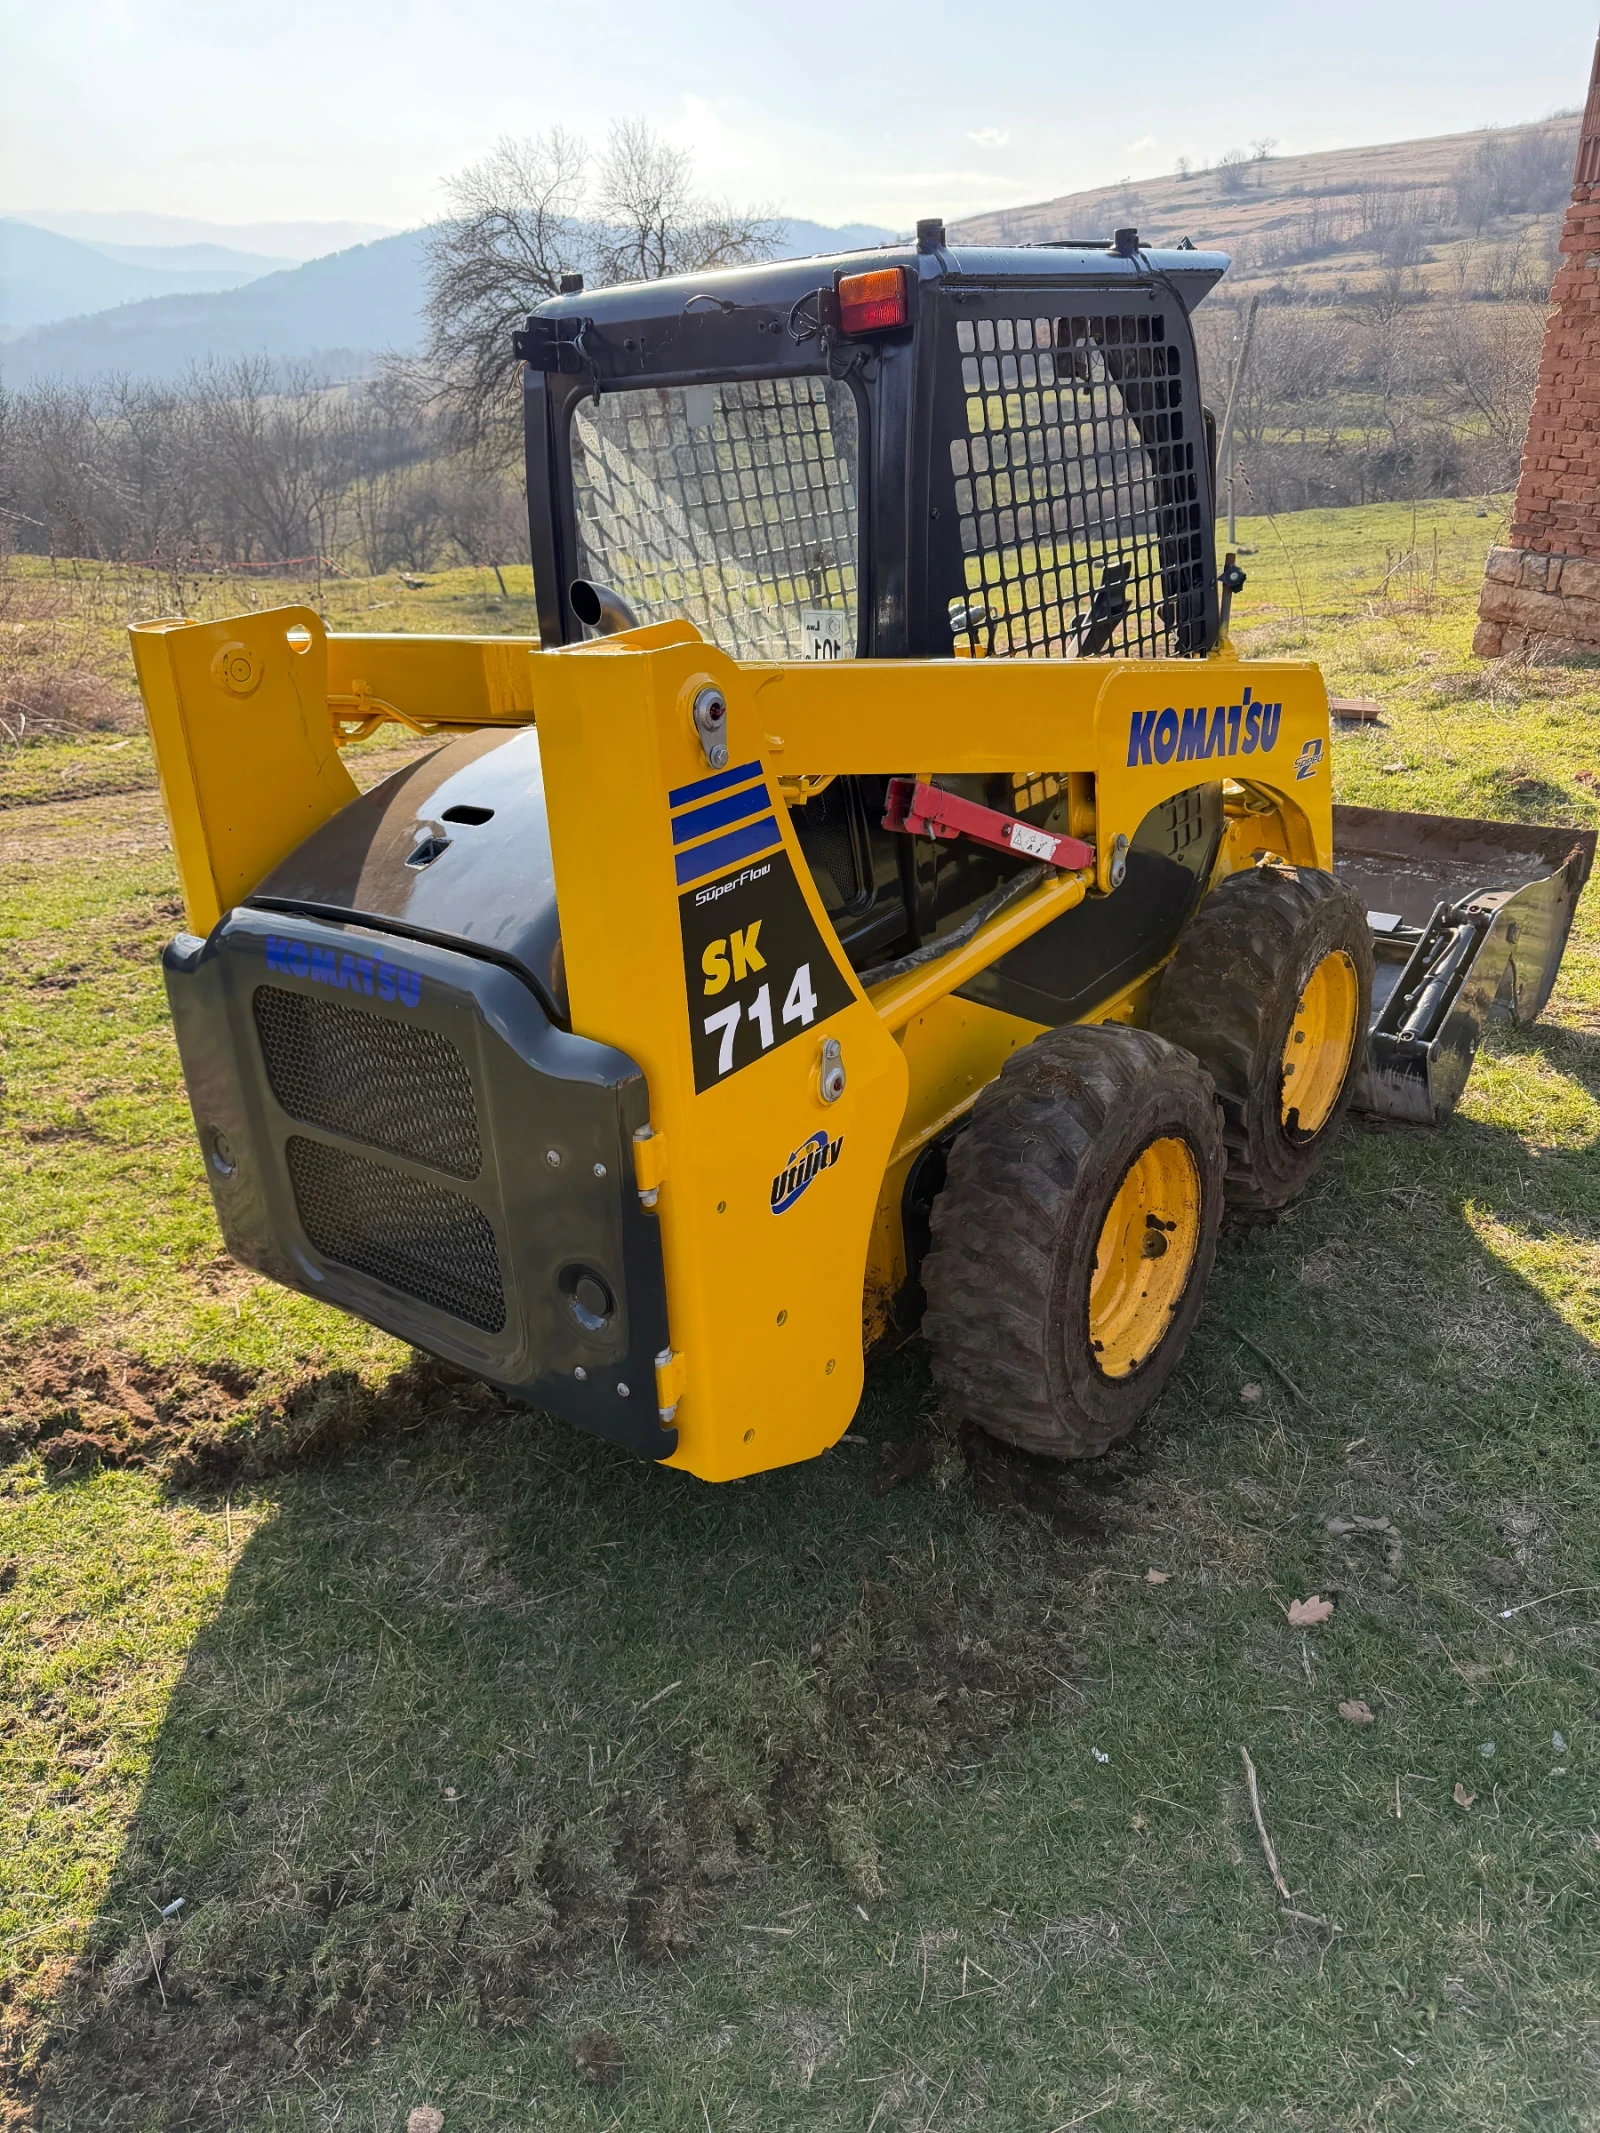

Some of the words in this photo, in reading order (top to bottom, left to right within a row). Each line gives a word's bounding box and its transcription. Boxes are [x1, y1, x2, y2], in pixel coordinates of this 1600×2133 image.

[1126, 686, 1282, 767] KOMATSU
[695, 863, 771, 906] SuperFlow
[266, 935, 422, 1008] KOMATSU
[701, 919, 767, 996] SK
[703, 962, 818, 1075] 714
[770, 1133, 845, 1206] Utility
